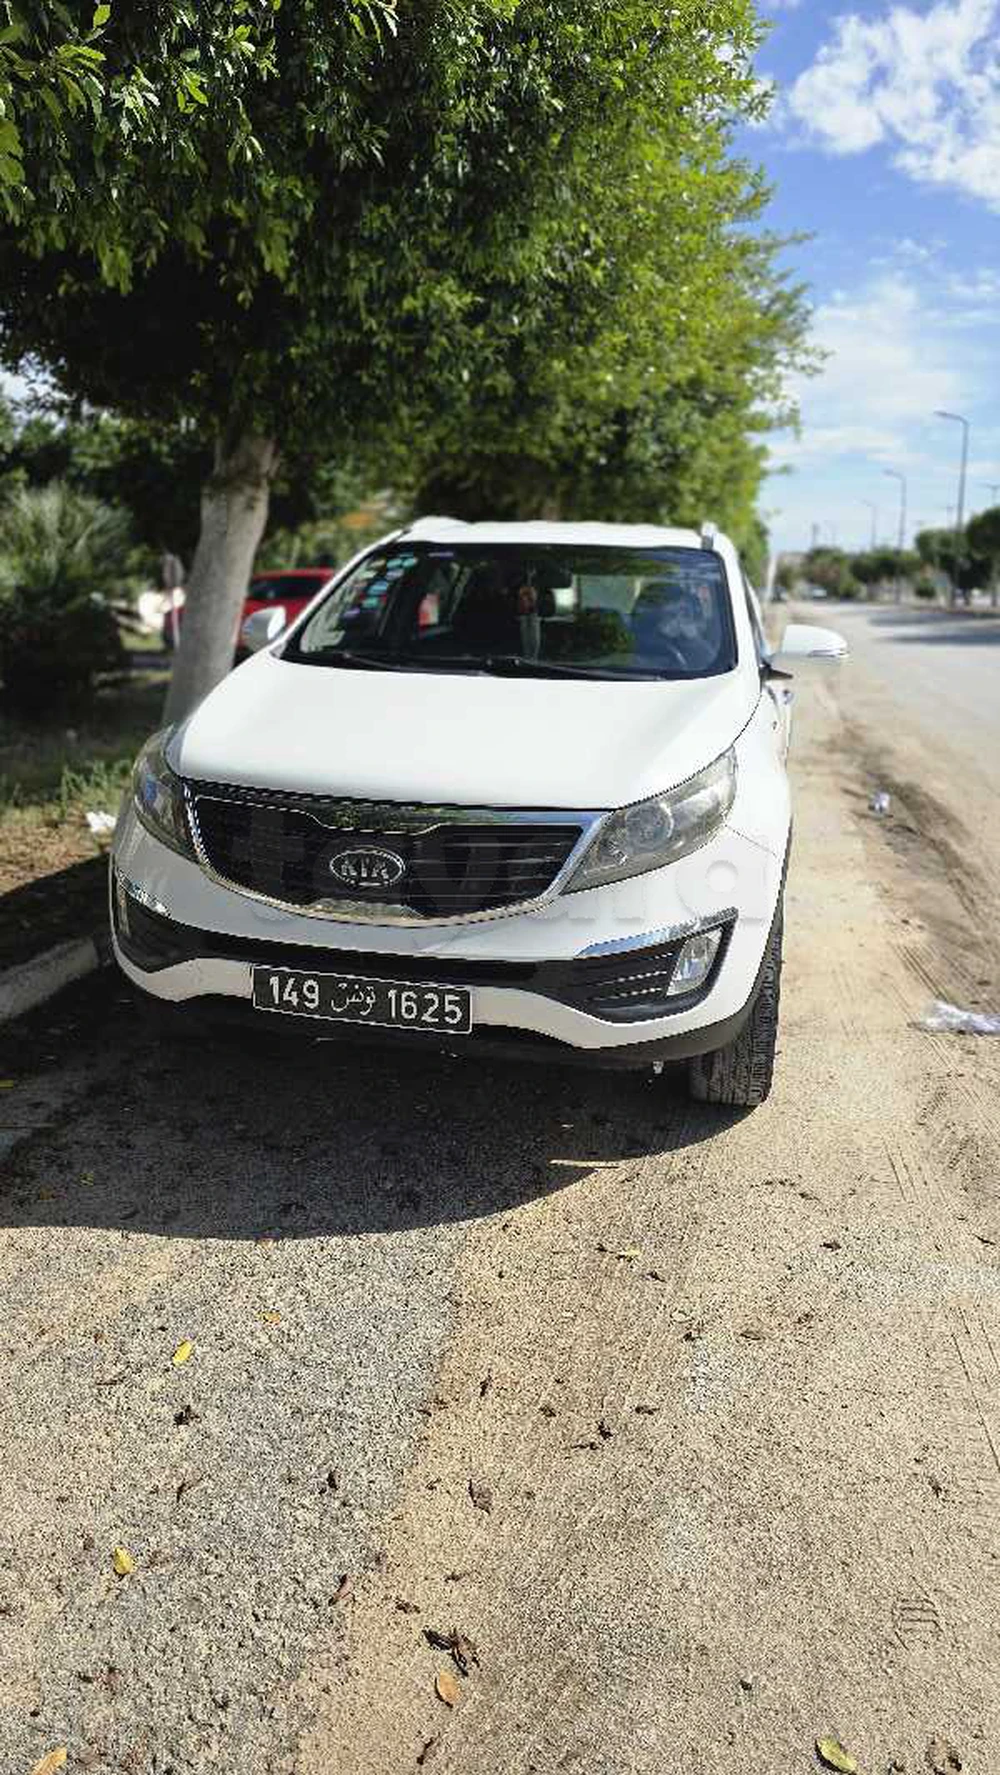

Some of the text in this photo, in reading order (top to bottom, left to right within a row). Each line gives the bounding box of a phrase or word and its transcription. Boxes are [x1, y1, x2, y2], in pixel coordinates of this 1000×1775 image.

[340, 857, 389, 879] KIA
[269, 975, 463, 1025] 149 تونس 1625
